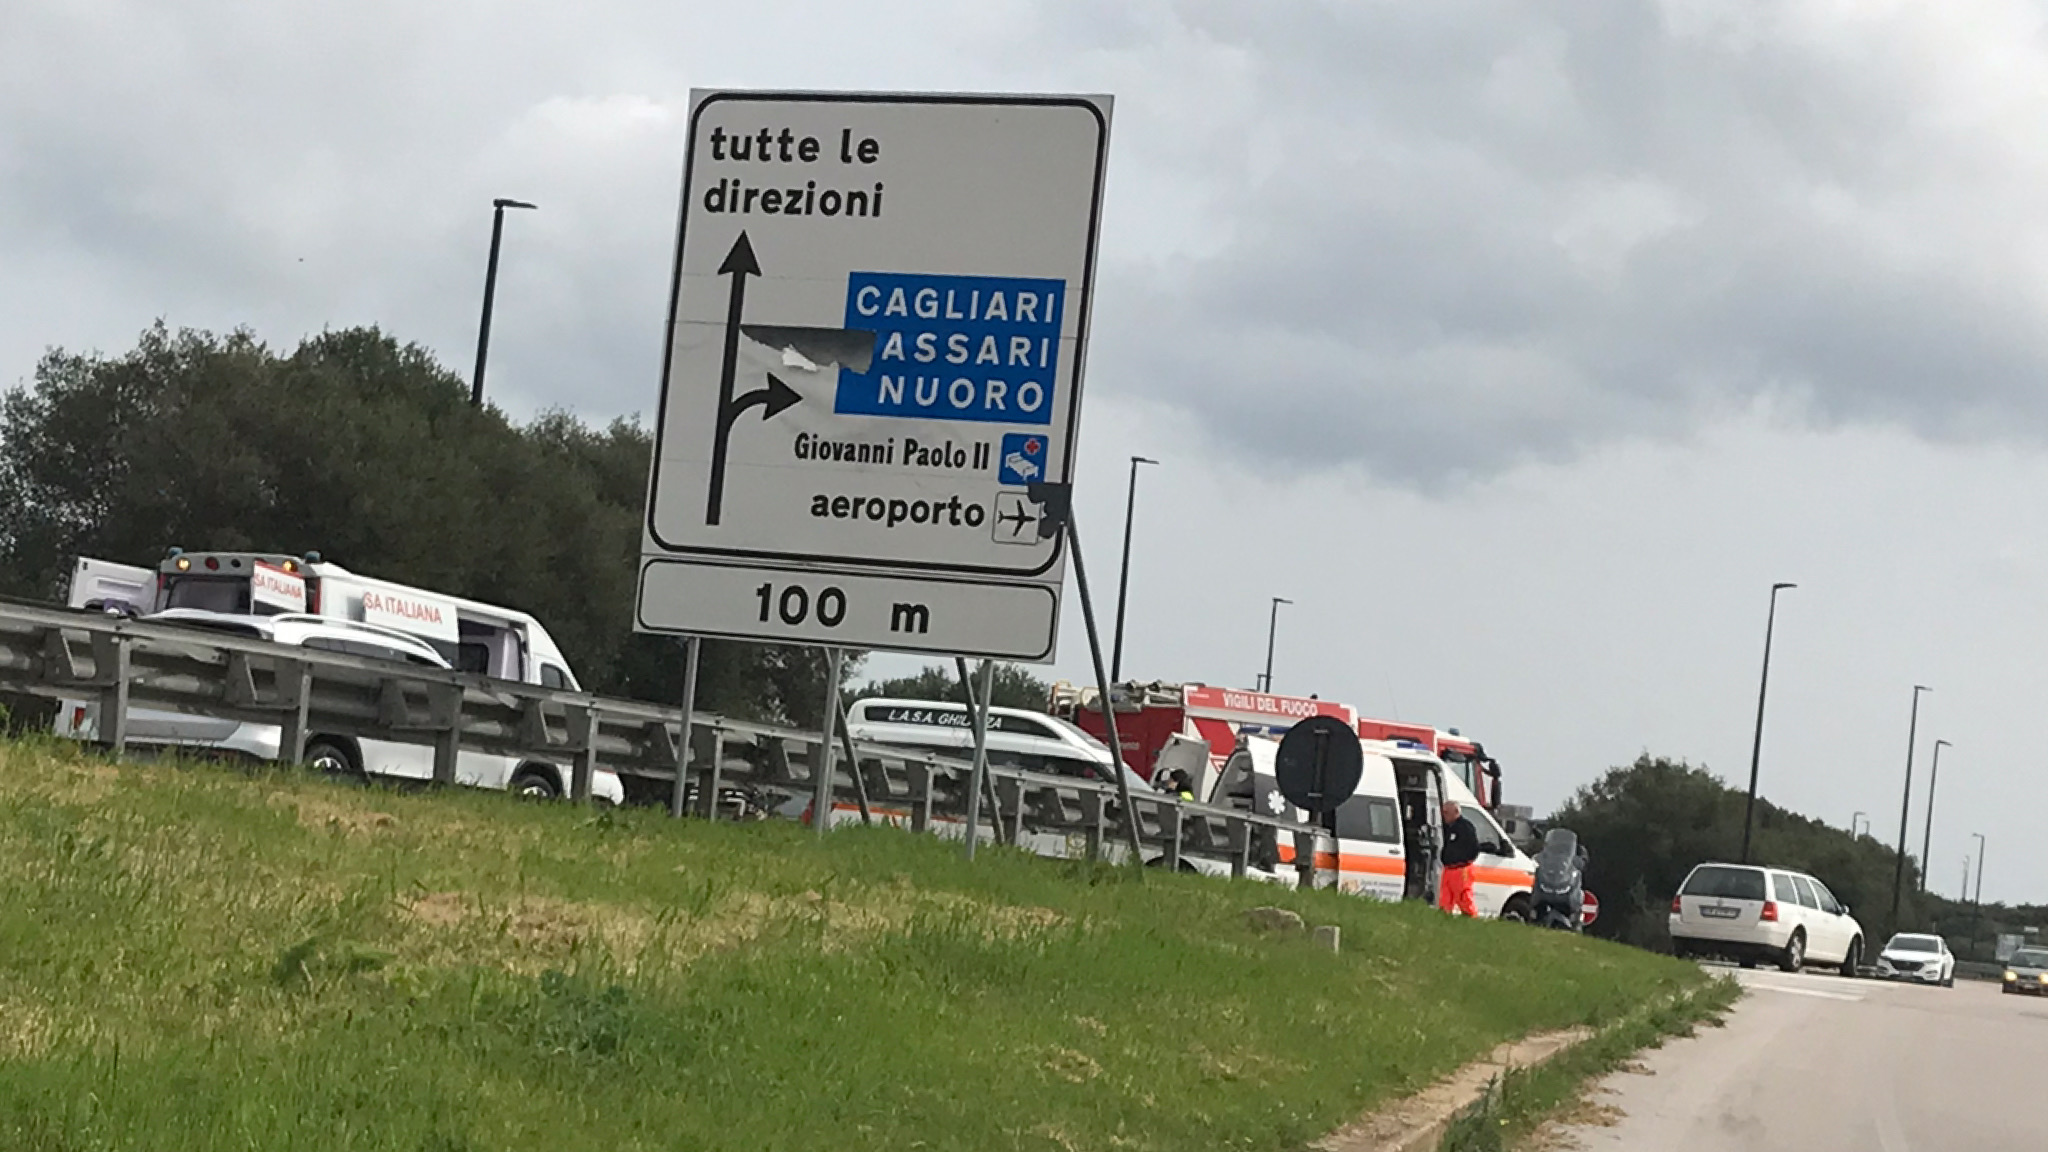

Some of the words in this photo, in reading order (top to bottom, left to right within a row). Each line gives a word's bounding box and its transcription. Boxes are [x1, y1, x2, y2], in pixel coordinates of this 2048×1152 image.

[710, 127, 820, 163] tutte
[841, 128, 880, 164] le
[704, 178, 884, 218] direzioni
[856, 285, 1055, 323] CAGLIARI
[881, 331, 1050, 369] ASSARI
[877, 375, 1044, 413] NUORO
[794, 431, 895, 466] Giovanni
[903, 438, 967, 469] Paolo
[973, 442, 990, 470] II
[810, 494, 986, 528] aeroporto
[385, 597, 443, 624] ITALIANA
[756, 582, 847, 628] 100
[890, 602, 930, 634] m
[938, 711, 1003, 730] GHILZA
[1222, 692, 1255, 710] VIGILI
[1256, 697, 1279, 713] DEL
[1280, 699, 1319, 717] FUOCO
